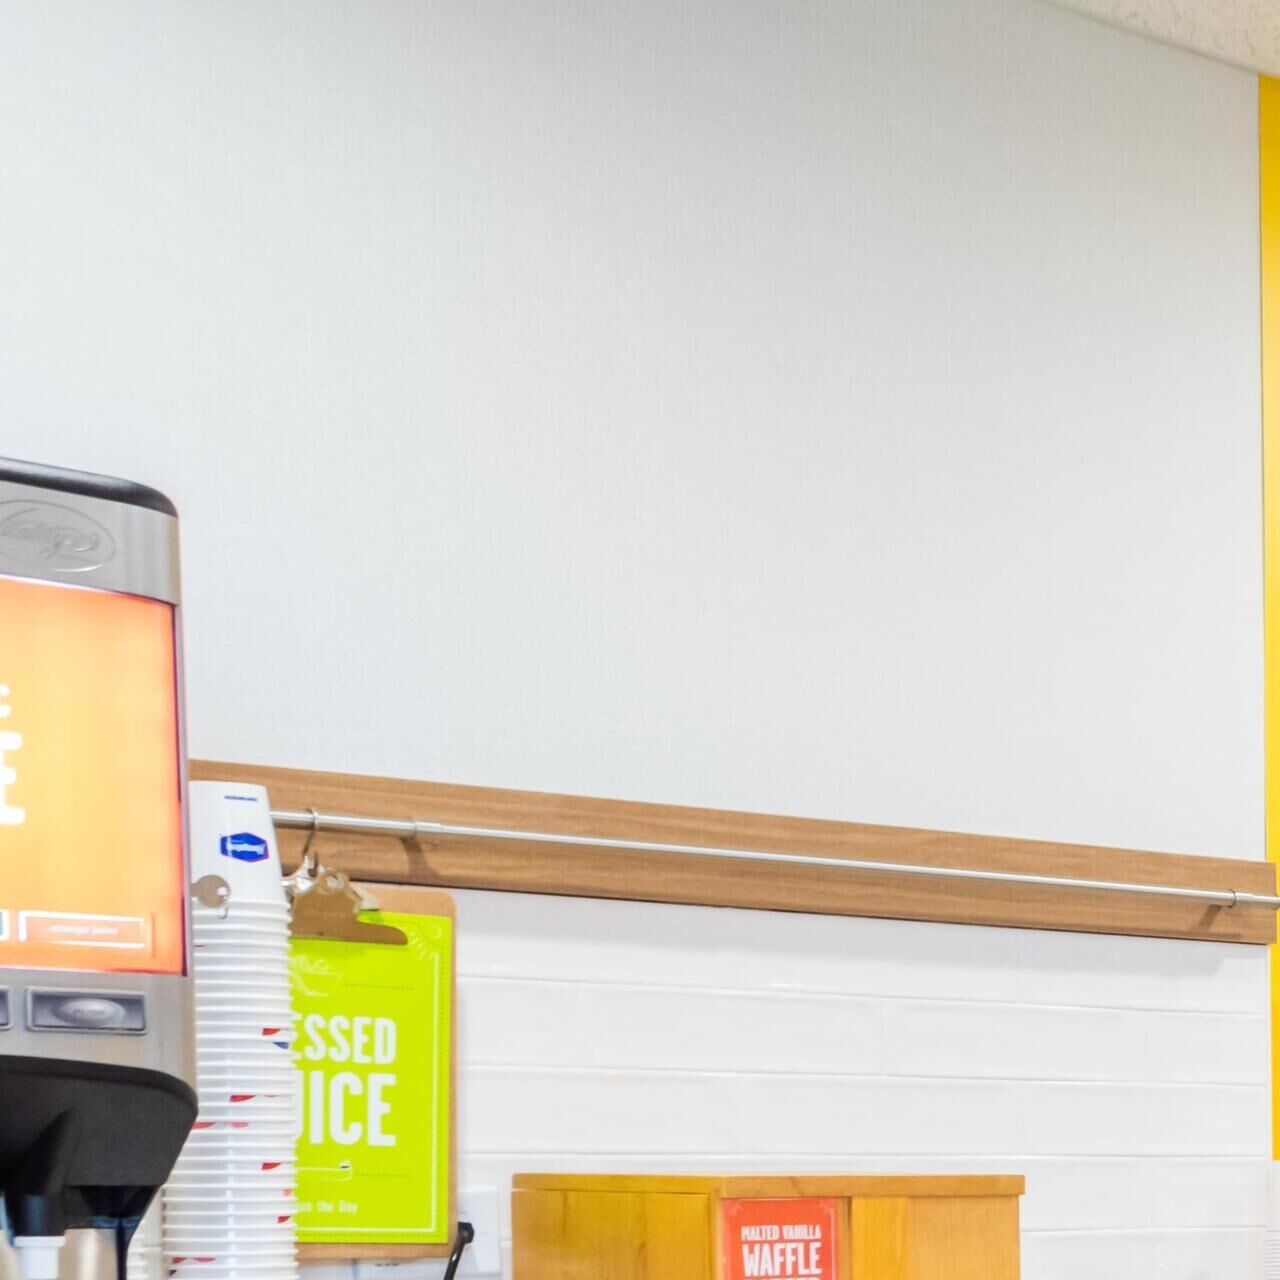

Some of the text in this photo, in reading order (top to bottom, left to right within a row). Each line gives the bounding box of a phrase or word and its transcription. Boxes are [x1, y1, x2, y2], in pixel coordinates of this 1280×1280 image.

[297, 1013, 397, 1065] SSED
[741, 1224, 822, 1241] MALTED VANILLA
[741, 1242, 823, 1277] WAFFLE
